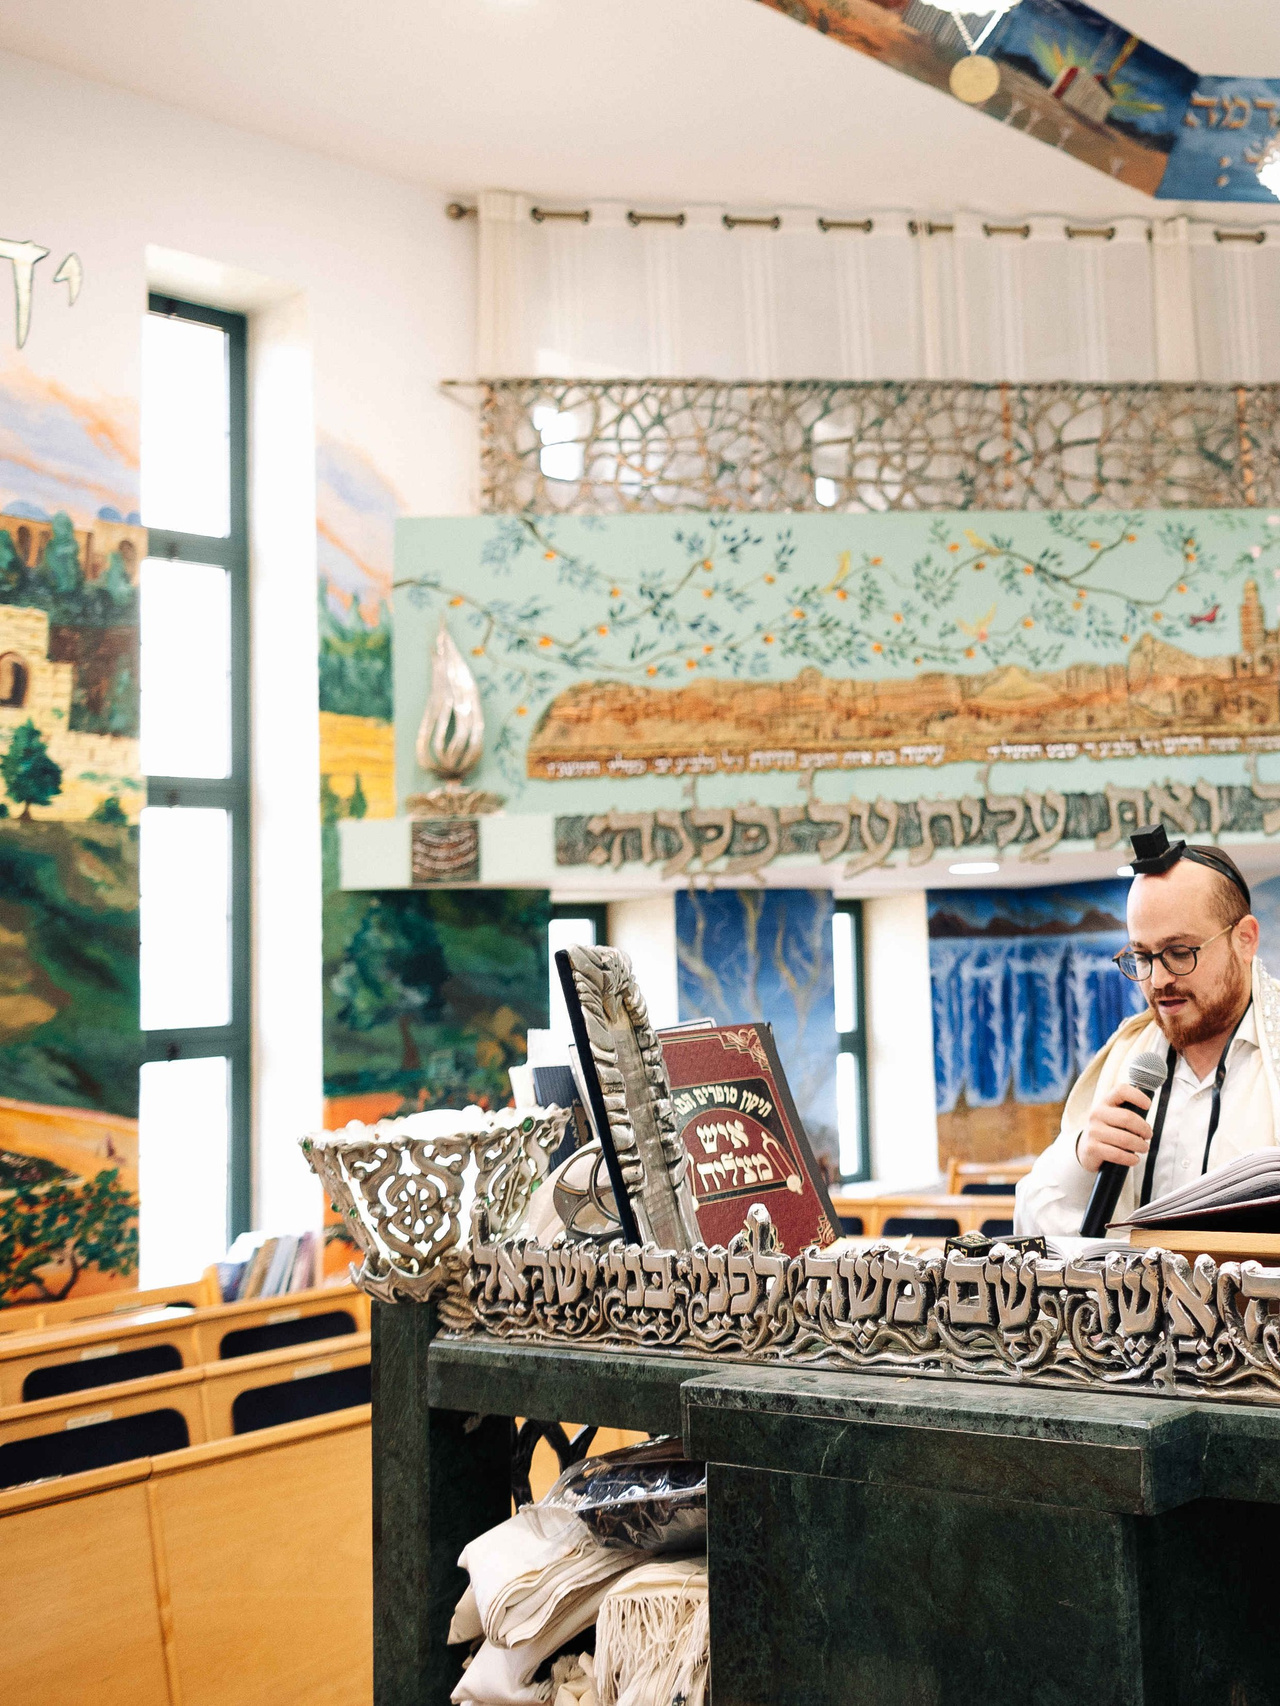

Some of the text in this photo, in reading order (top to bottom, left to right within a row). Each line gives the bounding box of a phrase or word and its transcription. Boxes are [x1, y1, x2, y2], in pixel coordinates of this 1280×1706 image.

[693, 1085, 738, 1106] סופרים
[739, 1090, 773, 1118] תיקון
[696, 1119, 749, 1154] איש
[696, 1152, 774, 1193] מצליח
[471, 1200, 600, 1304] ישראל
[601, 1240, 676, 1309] בני
[692, 1203, 792, 1316] לפני
[801, 1243, 926, 1324] משה
[945, 1243, 1038, 1332] שם
[1063, 1247, 1218, 1340] אשר
